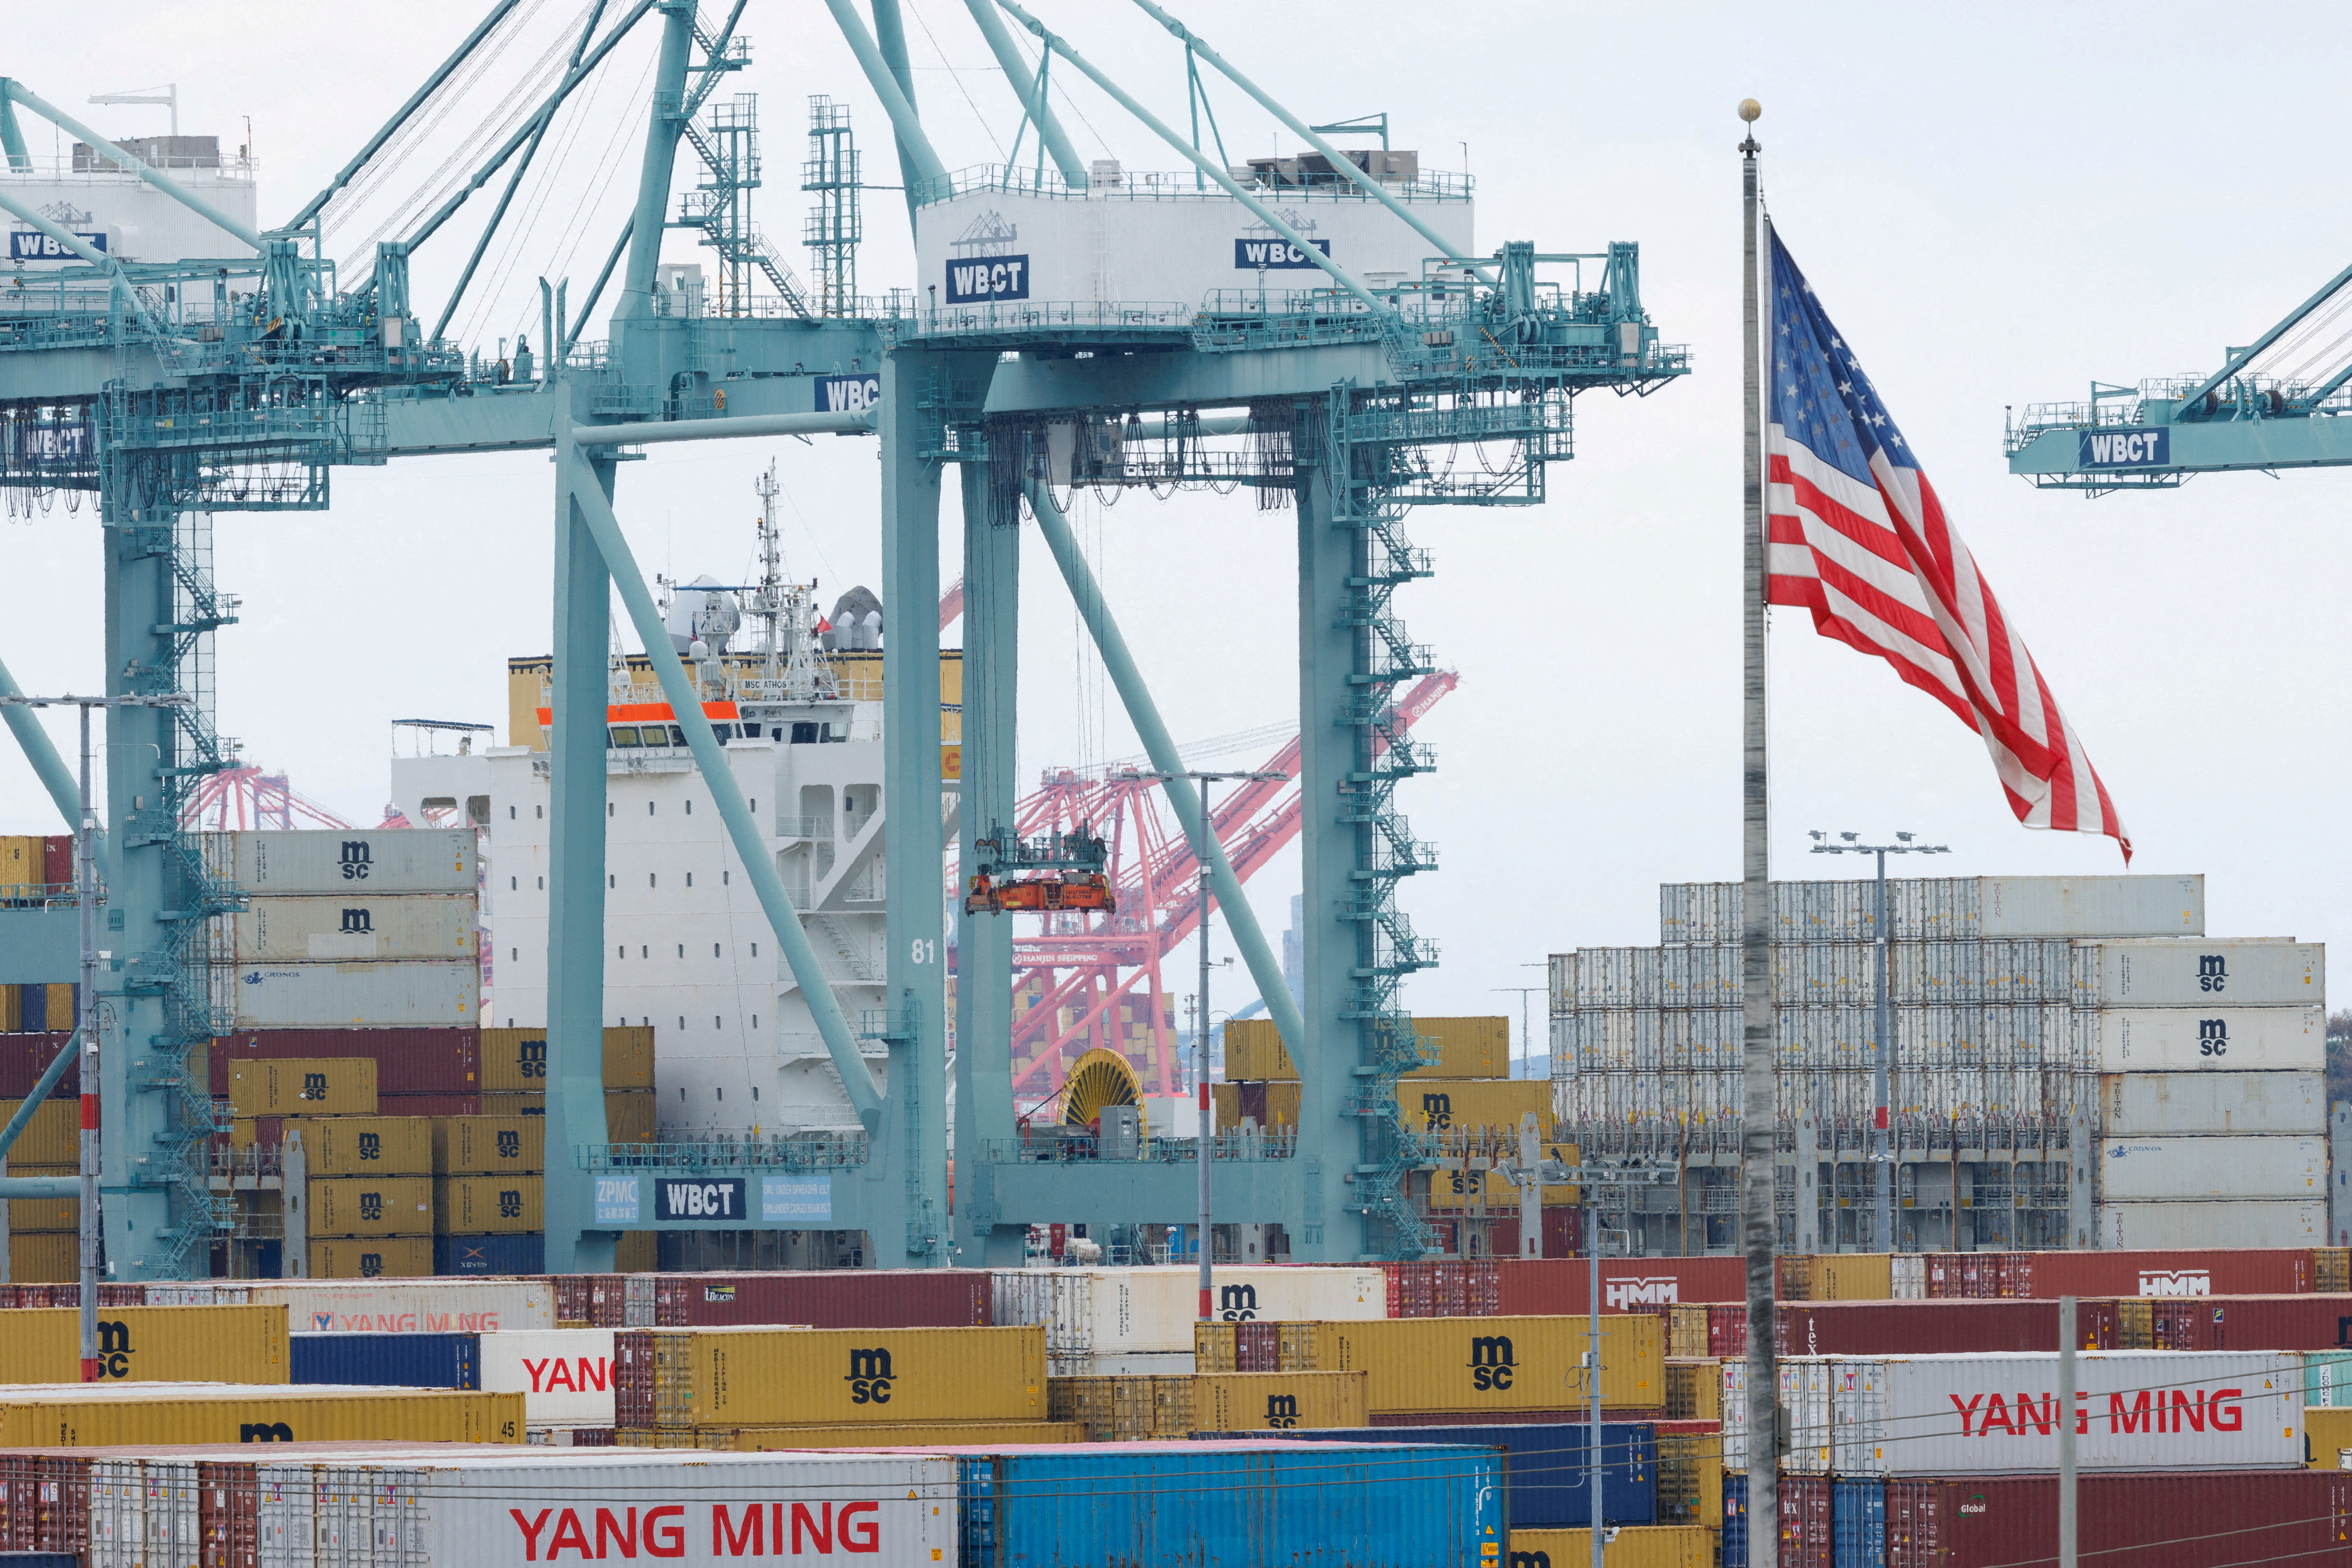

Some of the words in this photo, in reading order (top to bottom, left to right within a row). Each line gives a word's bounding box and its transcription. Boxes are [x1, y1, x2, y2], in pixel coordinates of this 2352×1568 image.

[17, 235, 95, 255] WB
[1246, 243, 1321, 263] WBC
[955, 262, 1021, 295] WBCT
[826, 379, 880, 412] WBC
[2091, 433, 2158, 462] WBCT
[338, 841, 374, 864] m
[342, 864, 369, 879] sc
[338, 909, 375, 932] m
[912, 939, 933, 964] 81
[1023, 955, 1055, 963] HANJIN
[1057, 954, 1097, 962] SHIPPING
[2196, 955, 2229, 977] m
[2200, 976, 2225, 992] sc
[1496, 1030, 1504, 1039] 45
[2196, 1019, 2230, 1040] m
[2200, 1040, 2226, 1056] sc
[302, 1073, 329, 1088] m
[306, 1089, 326, 1101] sc
[1419, 1093, 1454, 1114] m
[357, 1133, 383, 1147] m
[496, 1130, 521, 1146] m
[360, 1147, 380, 1160] sc
[499, 1145, 519, 1158] sc
[497, 1190, 524, 1206] m
[598, 1181, 636, 1202] ZPMC
[776, 1184, 791, 1194] UNDER
[792, 1184, 817, 1194] SPREADER
[359, 1192, 384, 1208] m
[667, 1184, 733, 1215] WBCT
[774, 1204, 789, 1214] UNDER
[791, 1203, 806, 1214] CARGO
[807, 1203, 820, 1213] BEAM
[361, 1208, 381, 1221] sc
[501, 1206, 520, 1218] sc
[359, 1253, 385, 1269] m
[2139, 1276, 2210, 1296] HMM
[710, 1291, 734, 1301] BEACON
[1216, 1284, 1261, 1311] m
[1606, 1282, 1677, 1310] HMM
[340, 1313, 416, 1332] YANG
[1126, 1324, 1129, 1332] CO
[1808, 1317, 1817, 1355] tex
[1466, 1336, 1519, 1367] m
[844, 1348, 897, 1381] m
[522, 1357, 615, 1392] YAN
[1473, 1366, 1513, 1391] sc
[722, 1395, 726, 1405] CO
[852, 1379, 891, 1404] sc
[1264, 1394, 1302, 1419] m
[1949, 1392, 2088, 1436] YANG
[2110, 1389, 2242, 1433] MING
[502, 1421, 514, 1438] 45
[1784, 1500, 1797, 1514] tex
[1961, 1504, 1985, 1512] Global
[510, 1506, 684, 1561] YANG
[713, 1502, 879, 1556] MING
